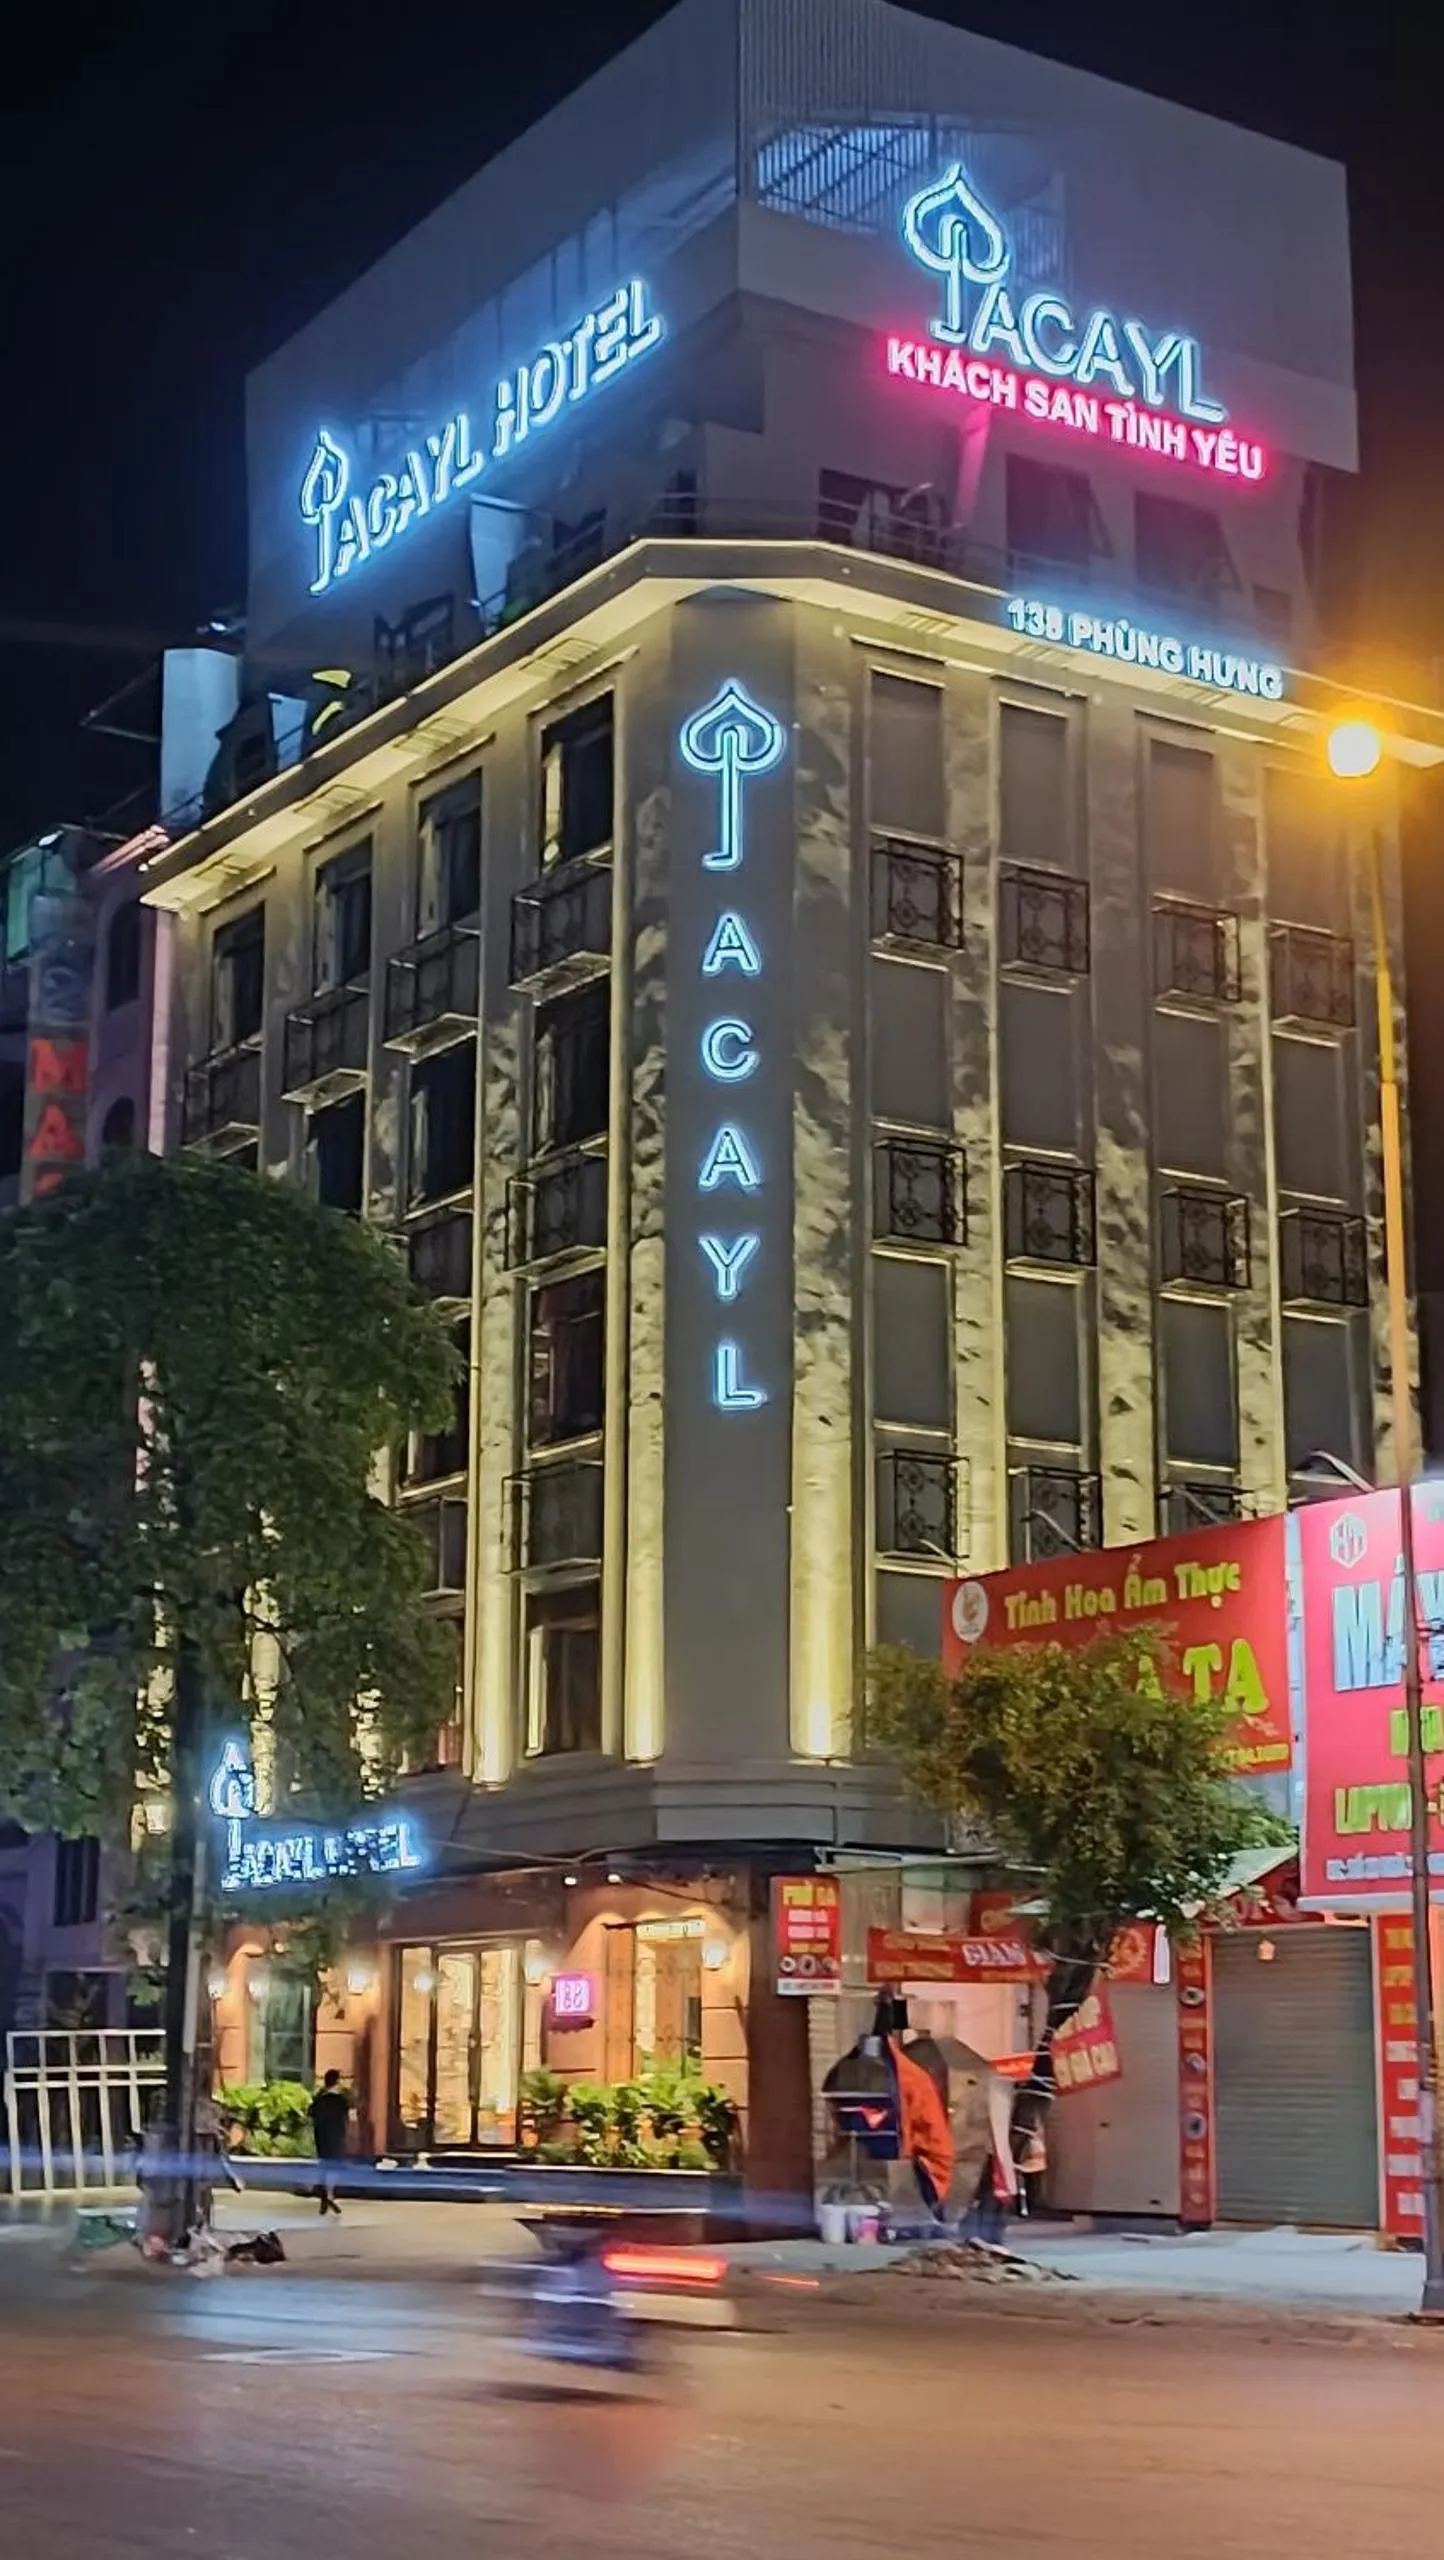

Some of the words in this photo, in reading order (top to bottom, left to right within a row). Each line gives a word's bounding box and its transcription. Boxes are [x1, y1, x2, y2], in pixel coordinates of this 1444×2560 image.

[492, 278, 663, 457] HOTEL
[886, 337, 1017, 410] KHÁCH
[1103, 401, 1187, 460] TÌNH
[1191, 428, 1265, 481] YÊU
[1007, 598, 1064, 641] 138
[1064, 1583, 1117, 1620] Hoa
[1175, 1561, 1241, 1609] Thực
